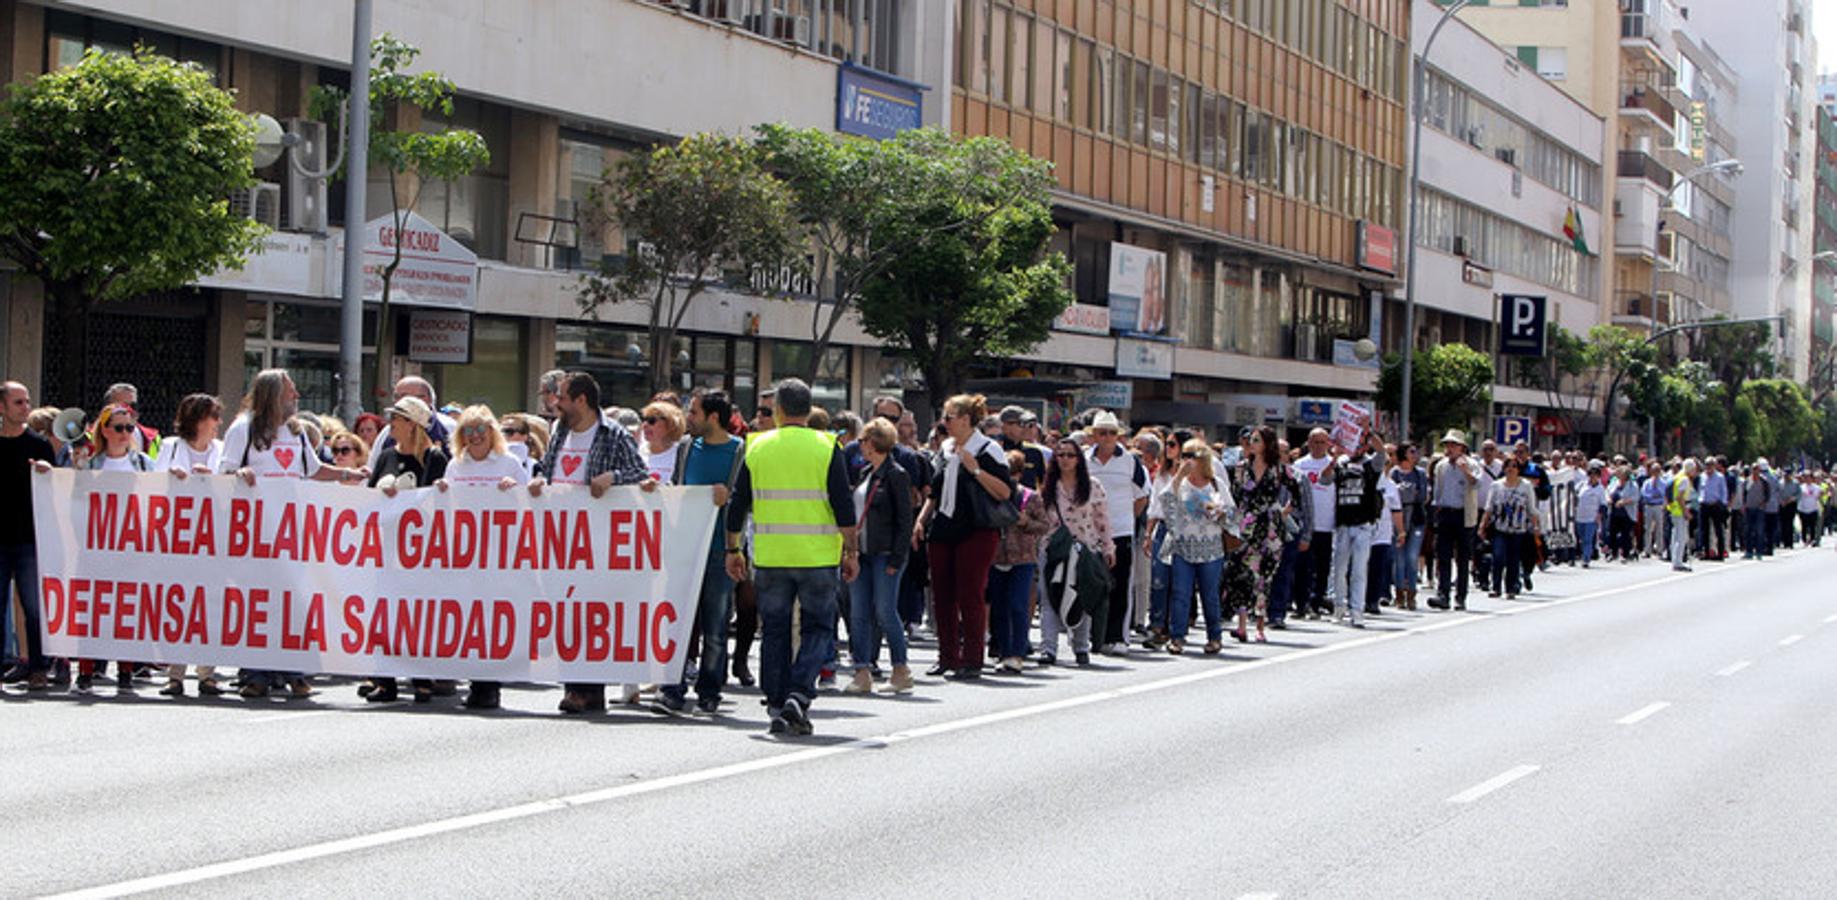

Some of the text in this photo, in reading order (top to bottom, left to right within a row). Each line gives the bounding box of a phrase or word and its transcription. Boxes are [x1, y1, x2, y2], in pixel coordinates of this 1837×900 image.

[1512, 297, 1535, 336] P
[1504, 420, 1523, 443] P
[87, 492, 661, 571] MAREA BLANCA GADITANA EN
[42, 576, 677, 663] DEFENSA DE LA SANIDAD PÚBLIC
